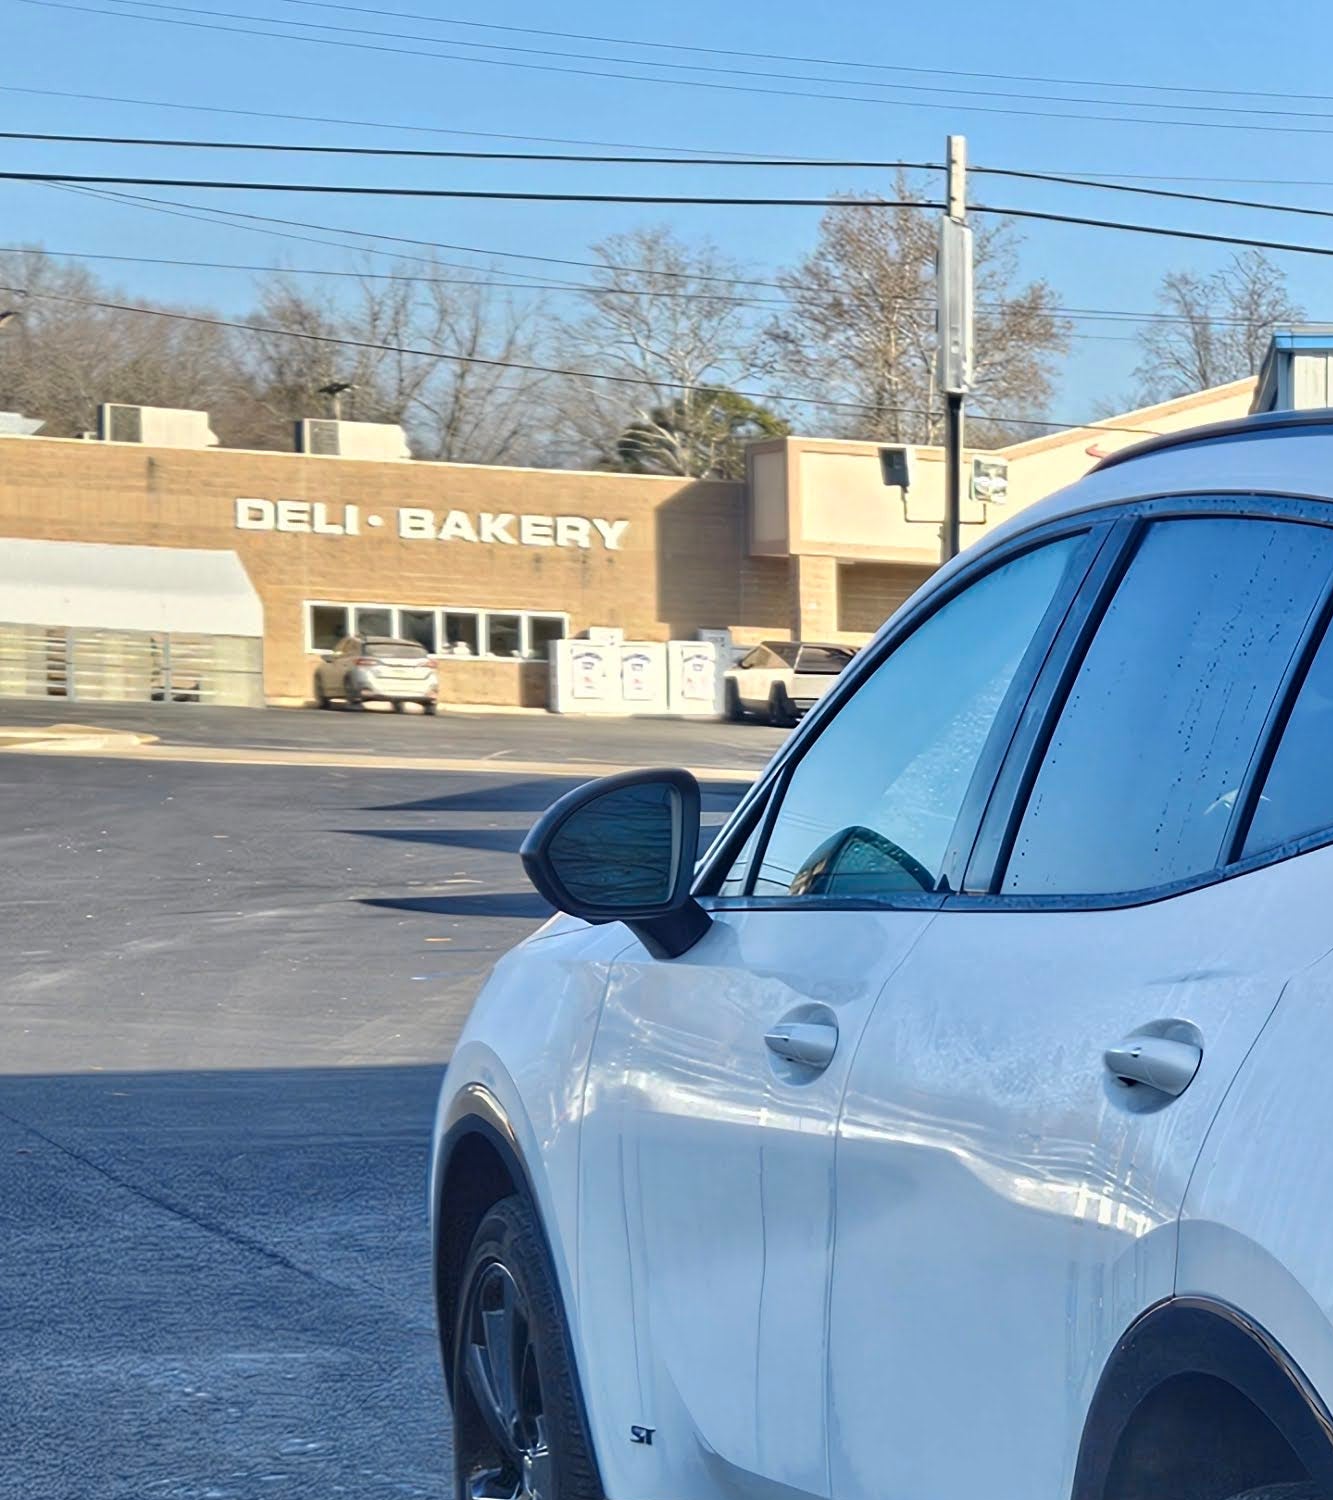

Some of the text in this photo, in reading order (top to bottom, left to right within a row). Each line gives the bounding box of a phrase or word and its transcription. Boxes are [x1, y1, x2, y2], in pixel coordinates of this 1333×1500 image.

[234, 497, 630, 550] DELI BAKERY
[630, 1425, 656, 1445] ST
